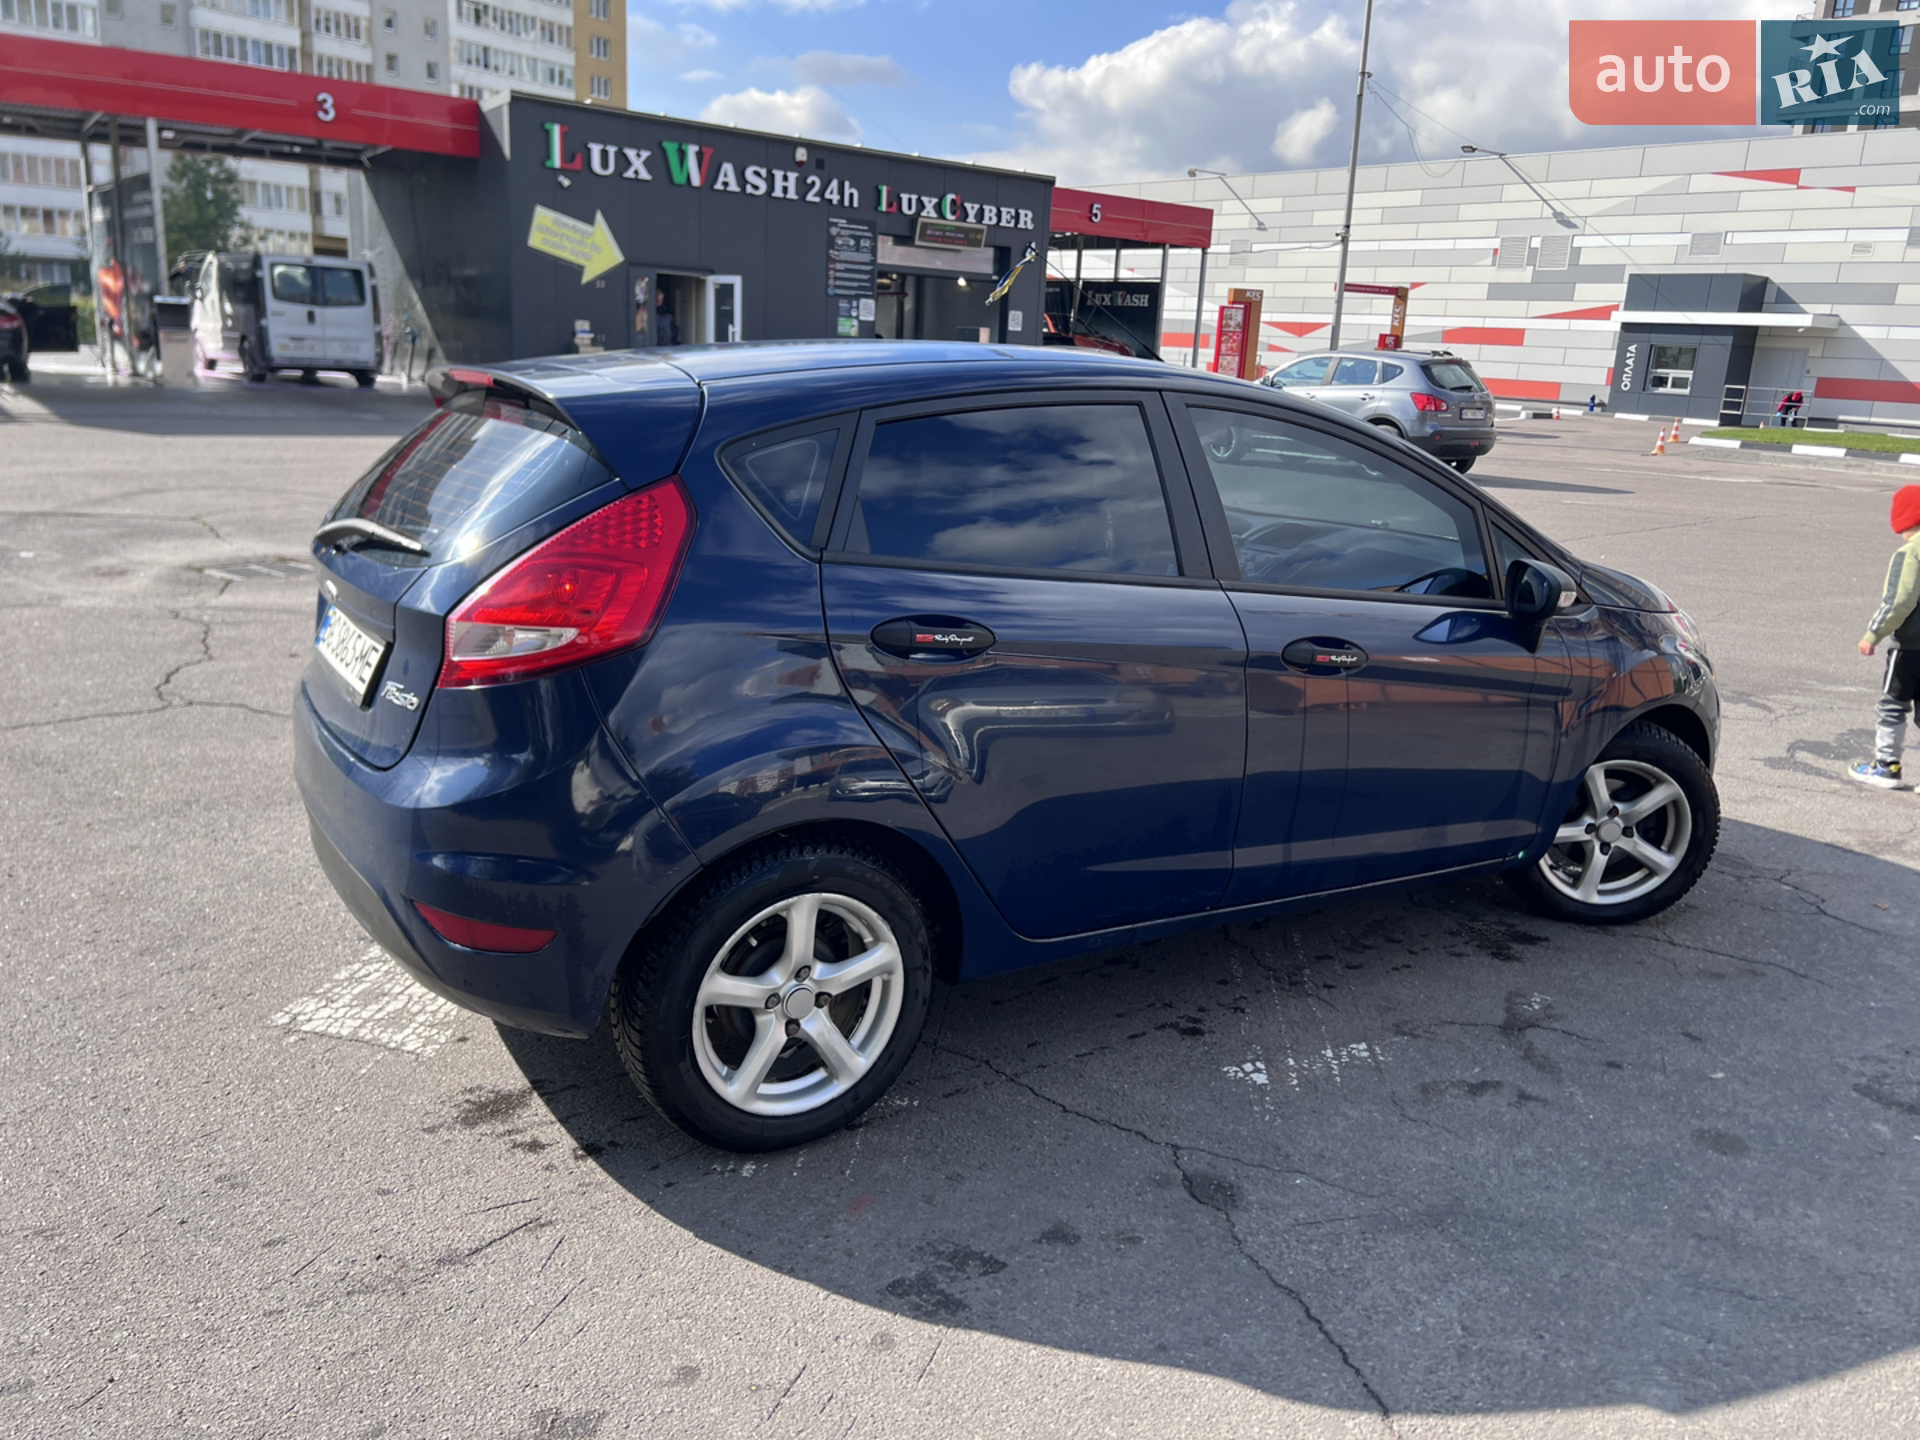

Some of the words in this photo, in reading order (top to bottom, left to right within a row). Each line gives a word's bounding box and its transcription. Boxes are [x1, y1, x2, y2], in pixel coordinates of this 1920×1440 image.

[316, 91, 336, 122] 3
[661, 140, 799, 201] WASH
[805, 175, 860, 208] 24h
[1091, 203, 1102, 223] 5
[1245, 290, 1262, 299] KFC
[1620, 343, 1637, 391] ОПЛАТА
[381, 680, 420, 711] Fiesta
